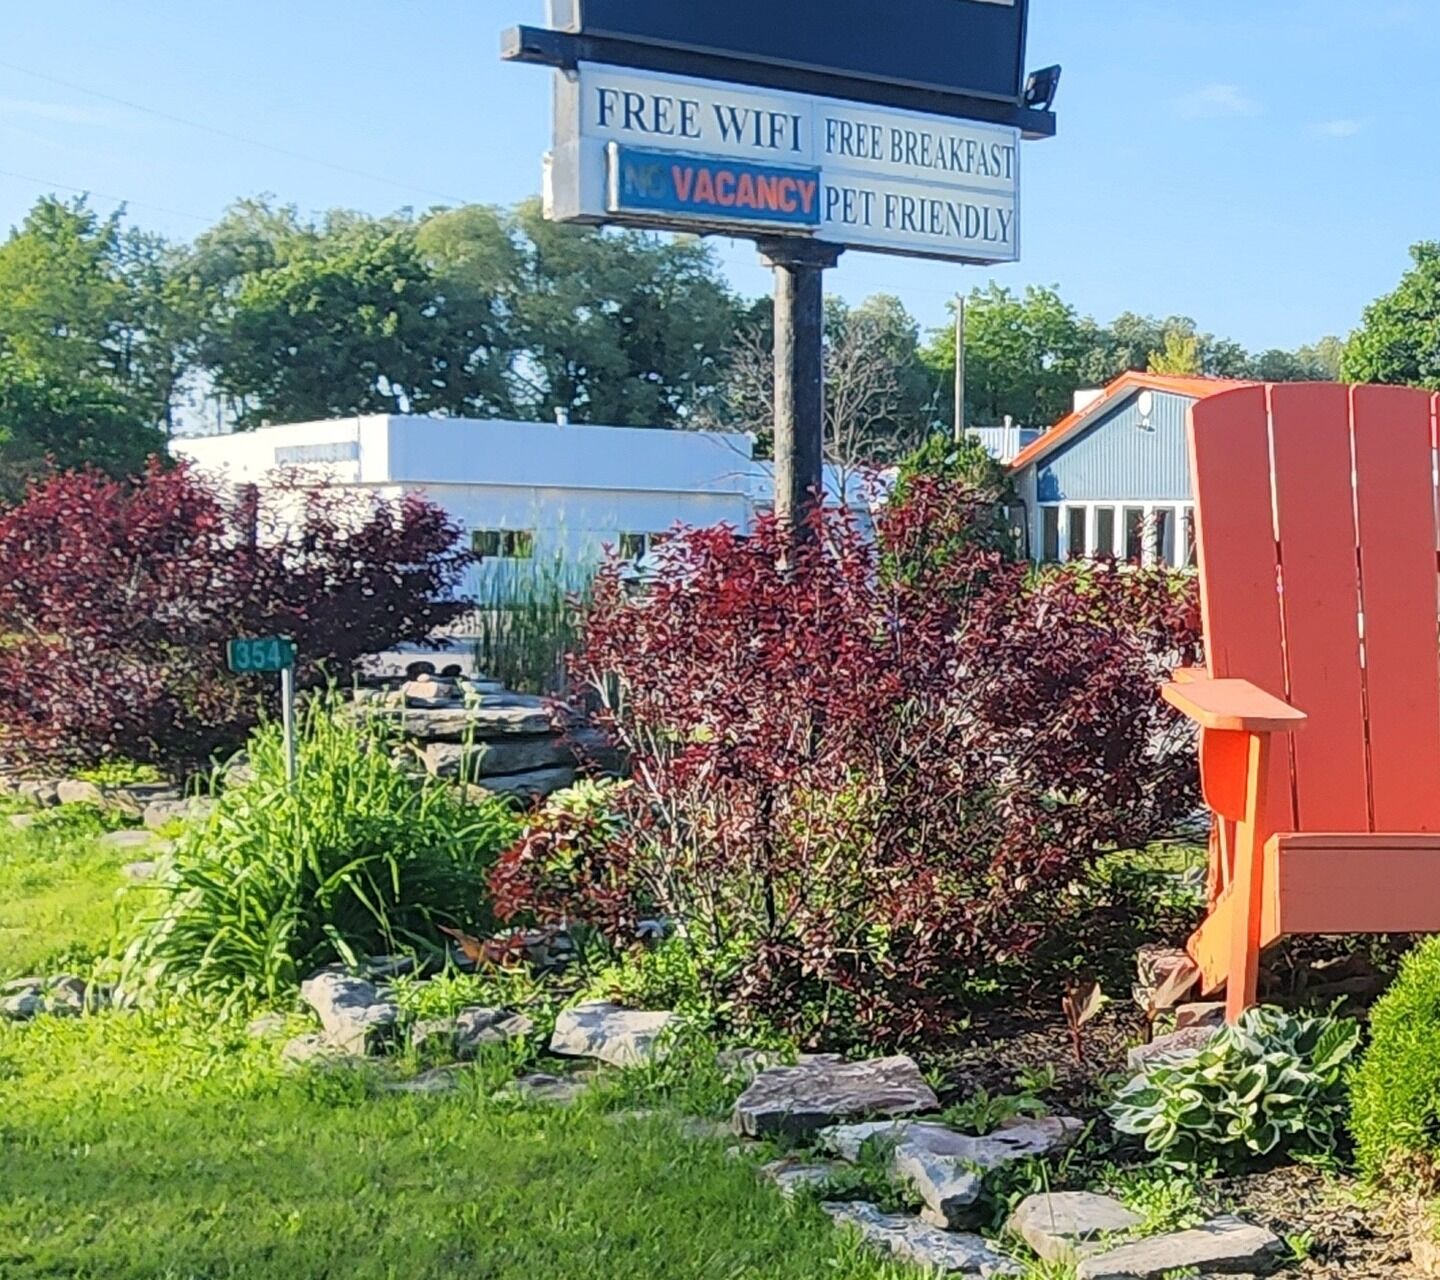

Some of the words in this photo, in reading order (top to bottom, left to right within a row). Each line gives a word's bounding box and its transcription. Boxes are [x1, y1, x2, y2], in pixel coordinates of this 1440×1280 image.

[596, 87, 702, 139] FREE
[712, 103, 802, 152] WIFI
[825, 118, 883, 161] FREE
[891, 127, 1015, 180] BREAKFAST
[672, 165, 816, 214] VACANCY
[825, 185, 876, 227] PET
[884, 193, 1014, 244] FRIENDLY
[236, 641, 281, 669] 354
